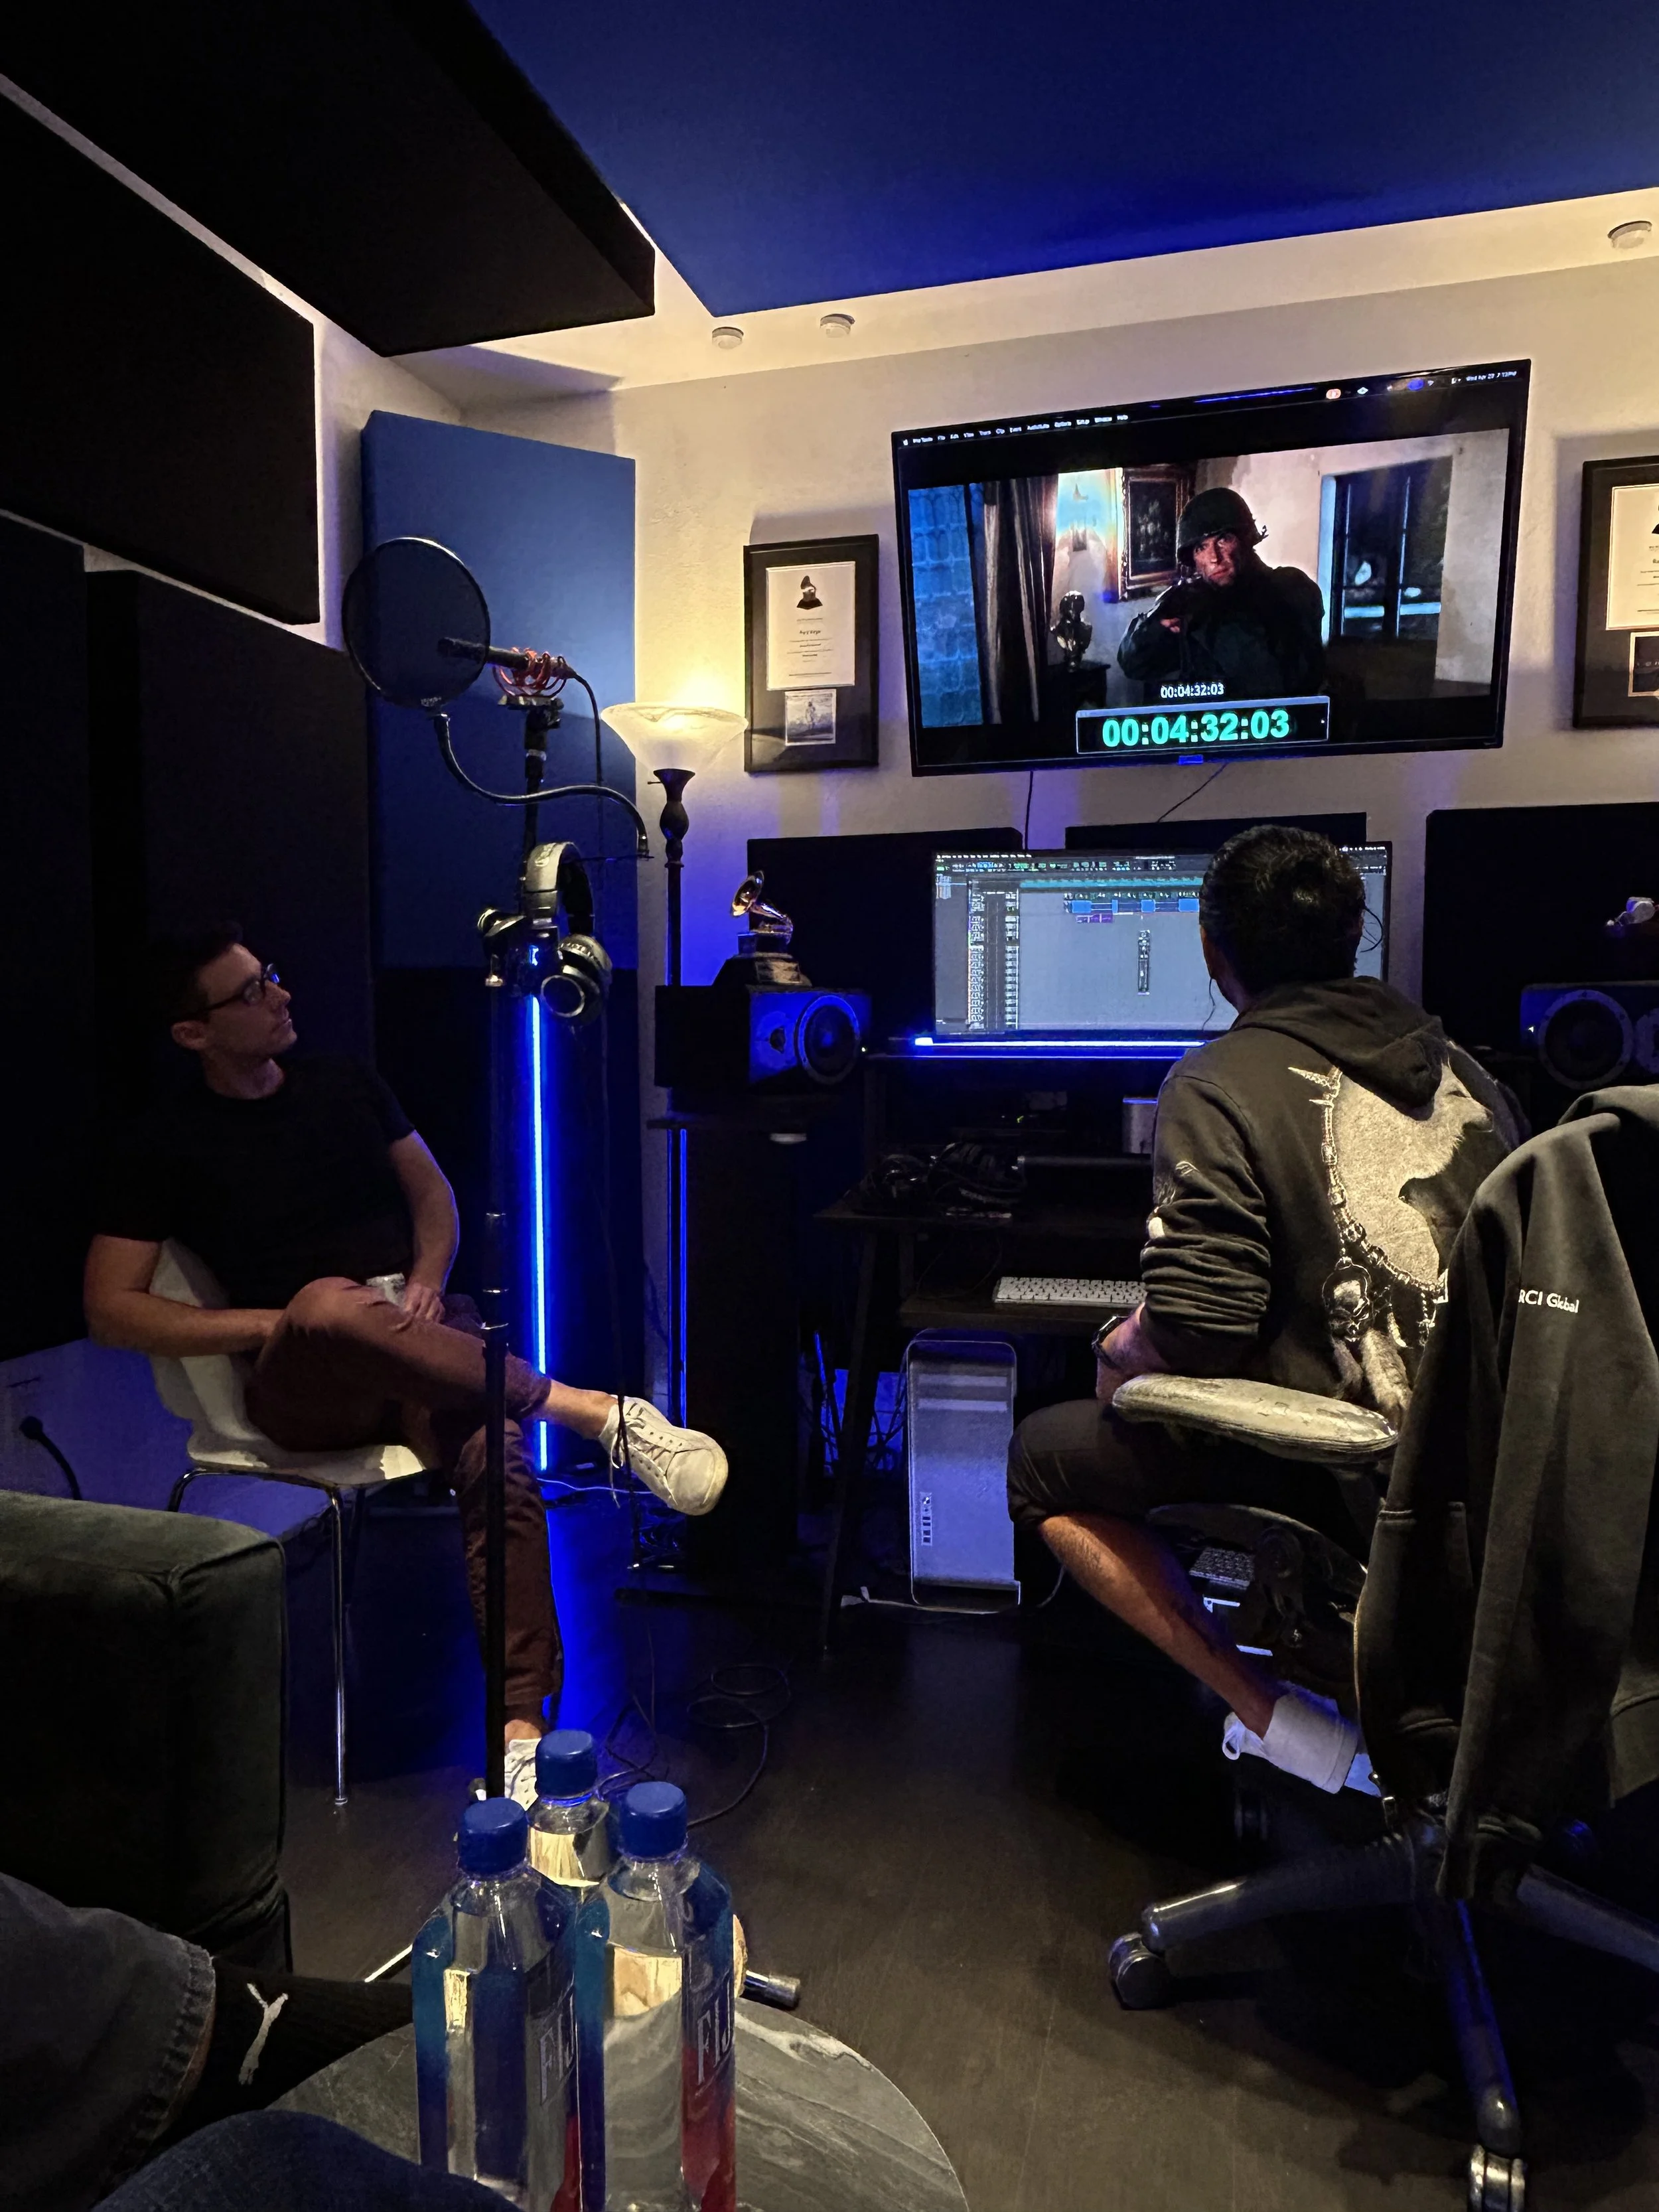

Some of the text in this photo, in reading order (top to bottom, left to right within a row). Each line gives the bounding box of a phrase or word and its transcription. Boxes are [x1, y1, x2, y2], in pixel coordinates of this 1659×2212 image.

[1161, 682, 1224, 698] 00:04:32:03
[1102, 709, 1290, 747] 00:04:32:03
[1546, 1293, 1579, 1313] Global
